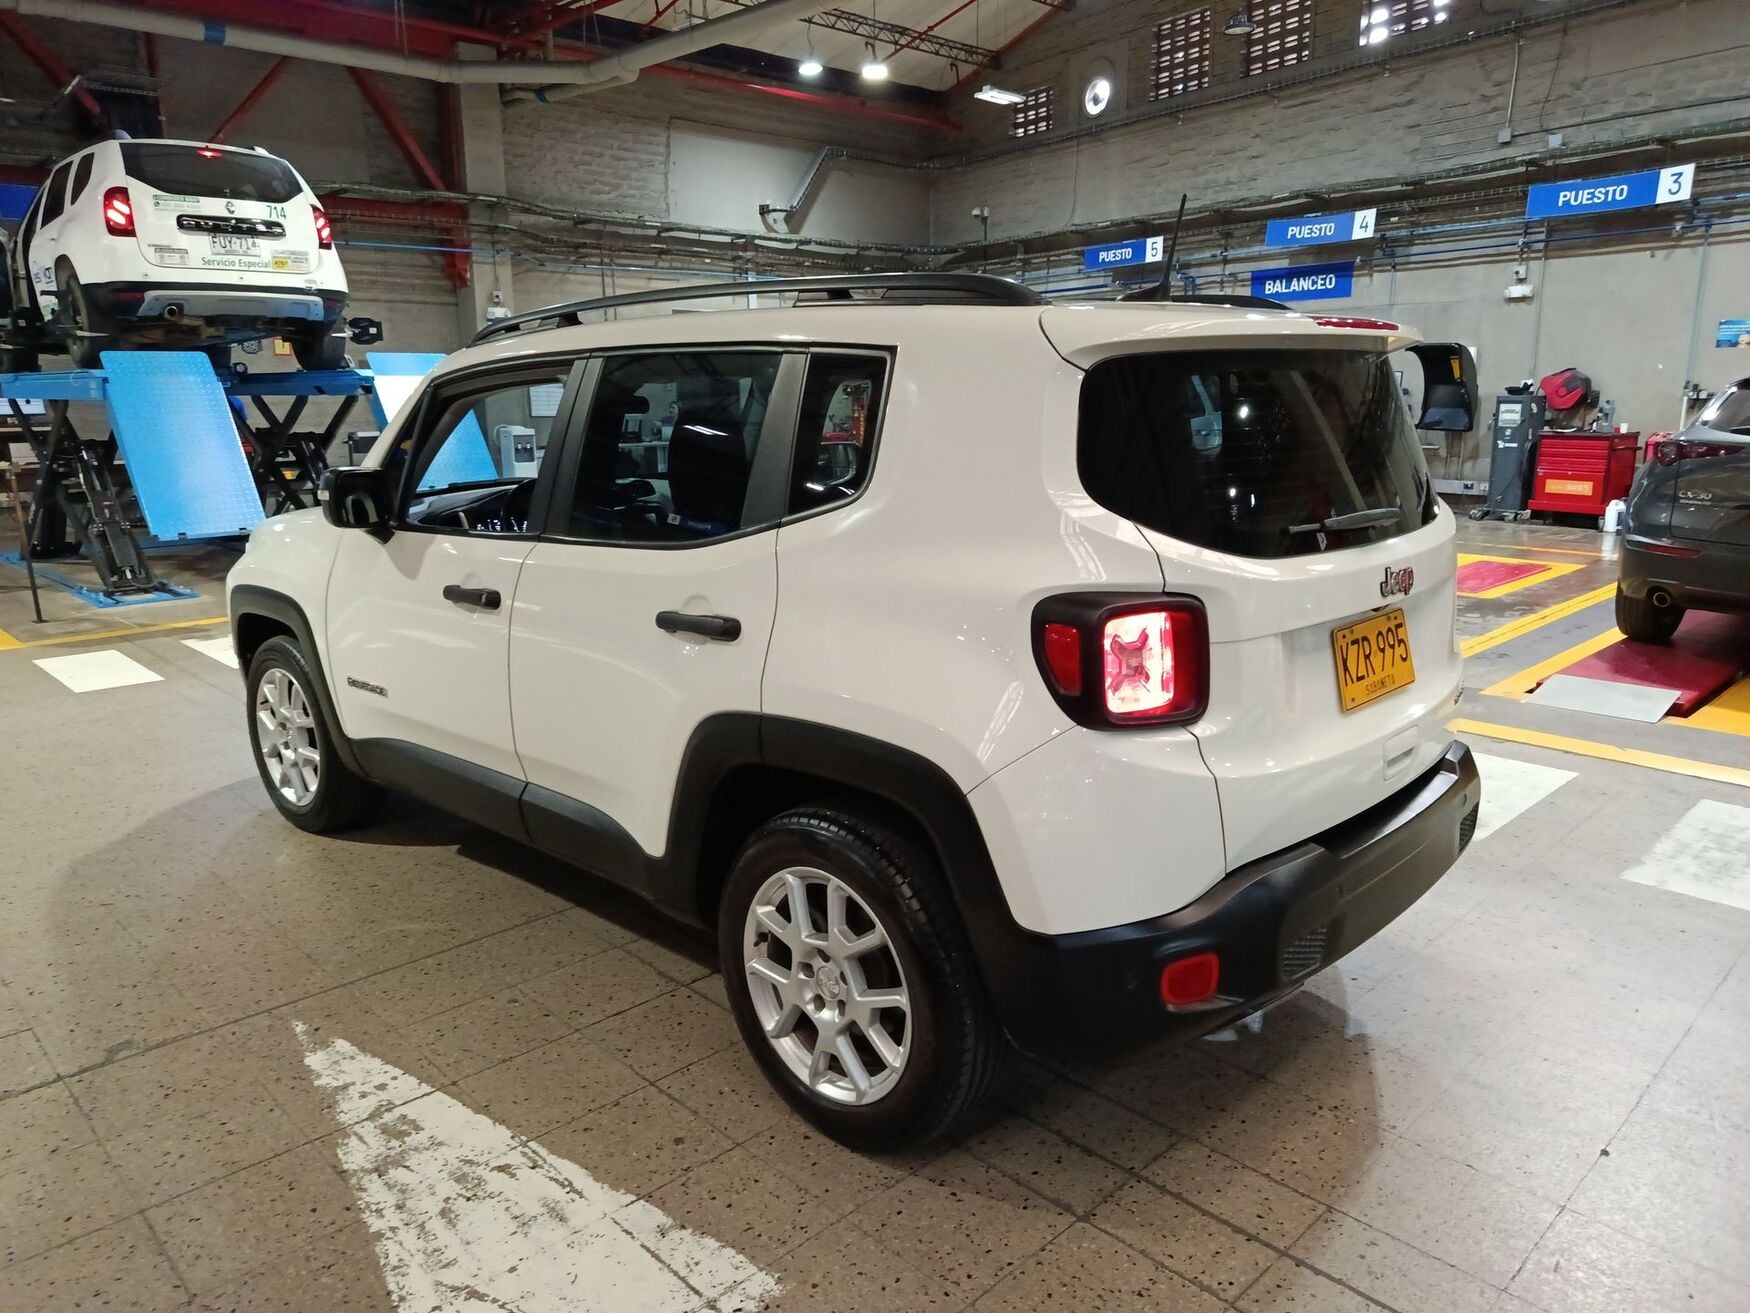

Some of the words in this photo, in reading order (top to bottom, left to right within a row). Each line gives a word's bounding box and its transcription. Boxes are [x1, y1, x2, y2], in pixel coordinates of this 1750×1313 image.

[1558, 184, 1629, 207] PUESTO
[1667, 171, 1684, 196] 3
[266, 205, 287, 220] 714
[1287, 222, 1335, 240] PUESTO
[1359, 215, 1369, 233] 4
[201, 256, 237, 268] Servicio
[238, 258, 271, 270] Especial
[1098, 247, 1133, 263] PUESTO
[1150, 241, 1159, 257] 5
[1264, 274, 1336, 295] BALANCEO
[1340, 635, 1375, 687] KZR
[1376, 622, 1409, 673] 995
